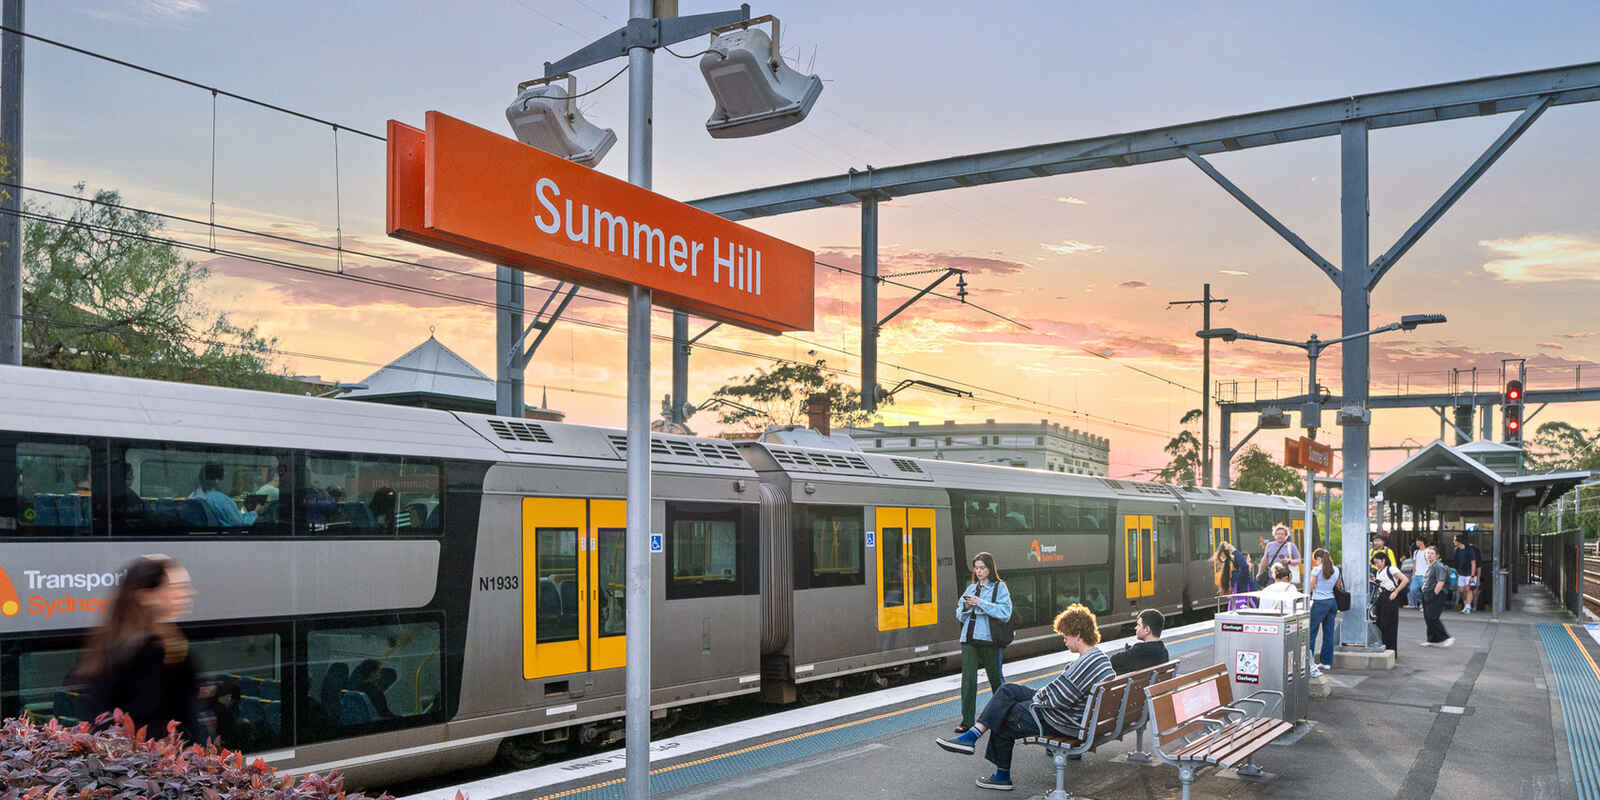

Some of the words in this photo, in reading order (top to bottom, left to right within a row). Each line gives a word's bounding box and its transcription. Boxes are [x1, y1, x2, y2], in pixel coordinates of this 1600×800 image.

[534, 177, 704, 276] Summer
[713, 236, 761, 295] Hill
[23, 568, 128, 592] Transpor
[479, 575, 519, 591] N1933
[28, 593, 110, 618] Sydney
